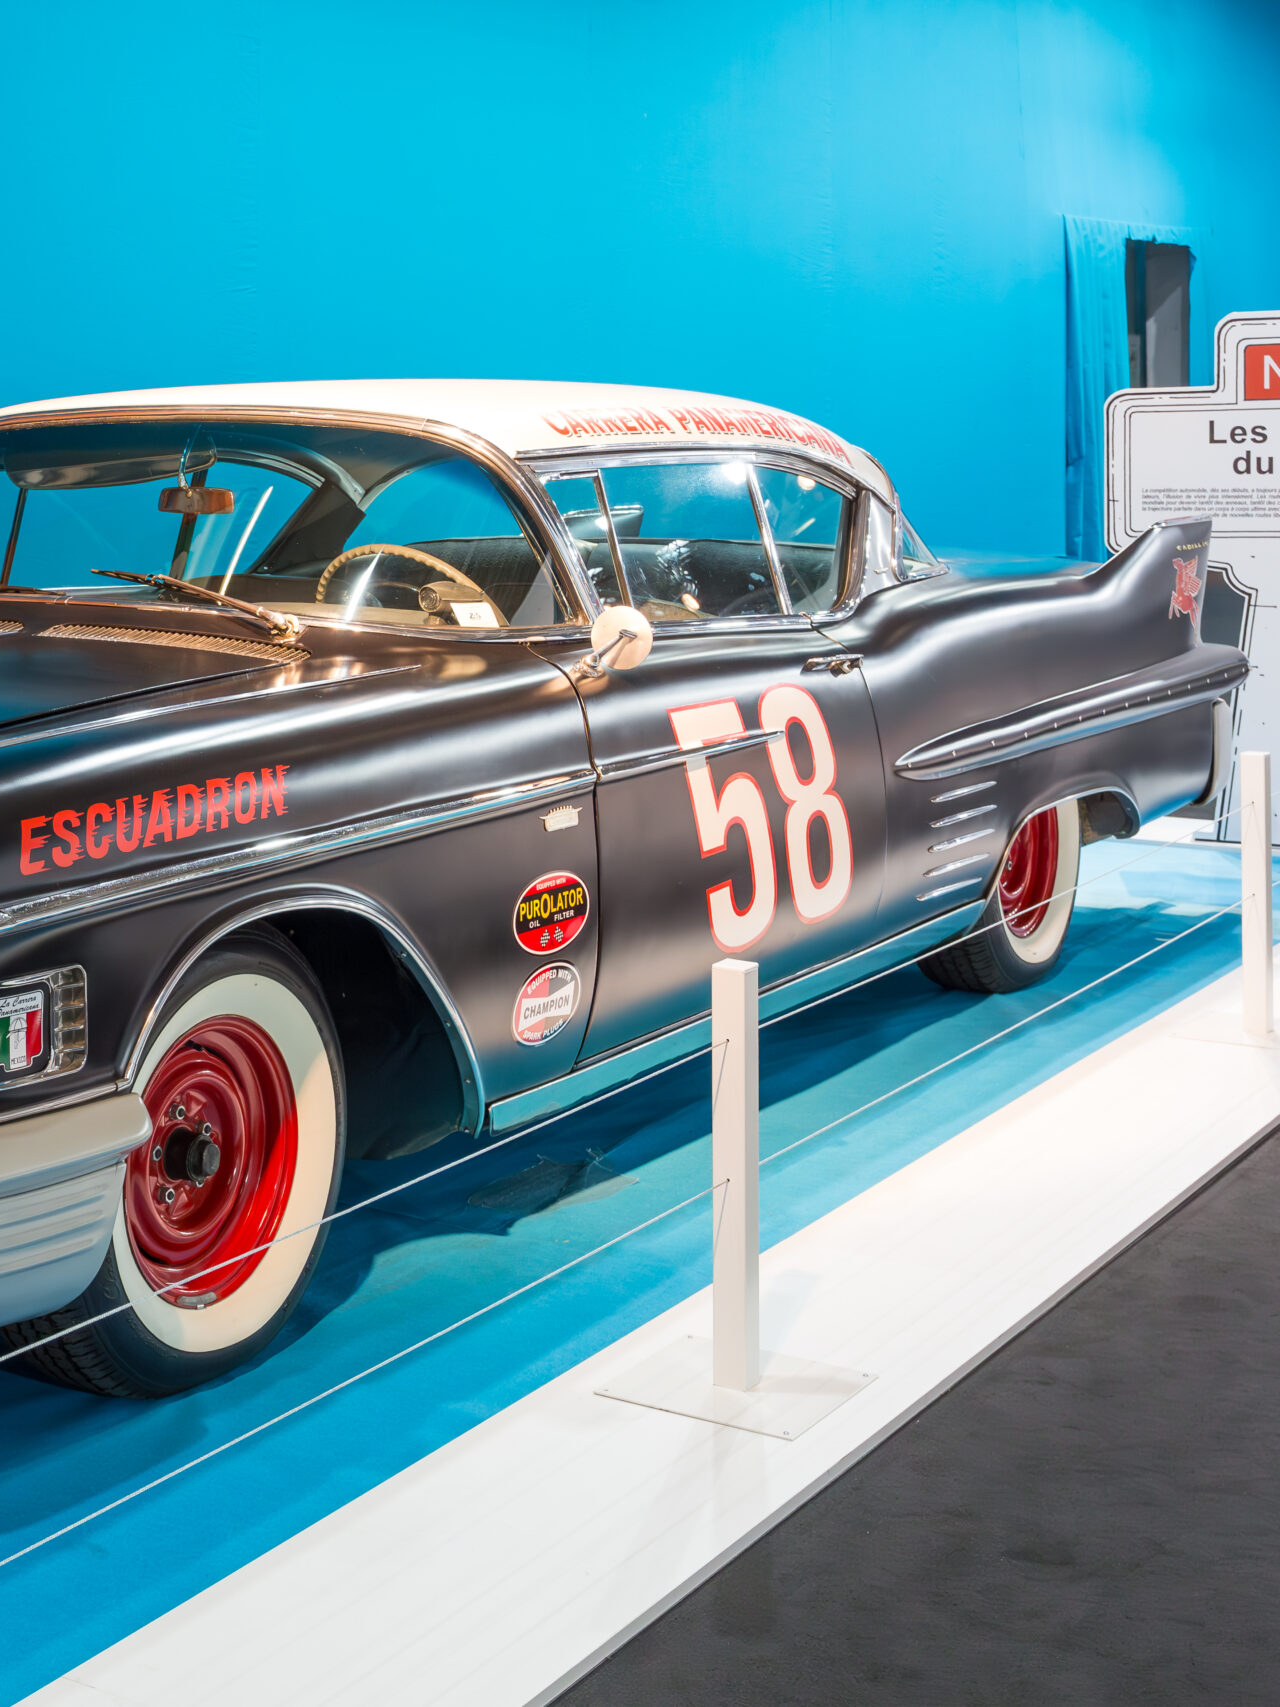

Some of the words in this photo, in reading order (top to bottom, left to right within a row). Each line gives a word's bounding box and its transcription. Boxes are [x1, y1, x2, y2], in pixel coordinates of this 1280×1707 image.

[539, 405, 671, 438] CARRERA
[667, 406, 854, 469] PANAMERICANA
[1208, 419, 1269, 445] Les
[1232, 450, 1274, 475] du
[20, 764, 291, 876] ESCUADRON
[666, 682, 854, 954] 58
[536, 880, 556, 891] EQUIPPED
[519, 887, 584, 922] PUROLATOR
[529, 920, 541, 929] OIL
[554, 909, 575, 922] FILTER
[527, 969, 557, 995] EQUIPPED
[557, 968, 572, 983] WITH
[0, 999, 10, 1008] La
[12, 994, 37, 1007] Carrera
[523, 994, 570, 1020] CHAMPION
[523, 1030, 543, 1041] SPARK
[542, 1018, 564, 1038] PLUGS
[10, 1055, 27, 1065] MEXICO
